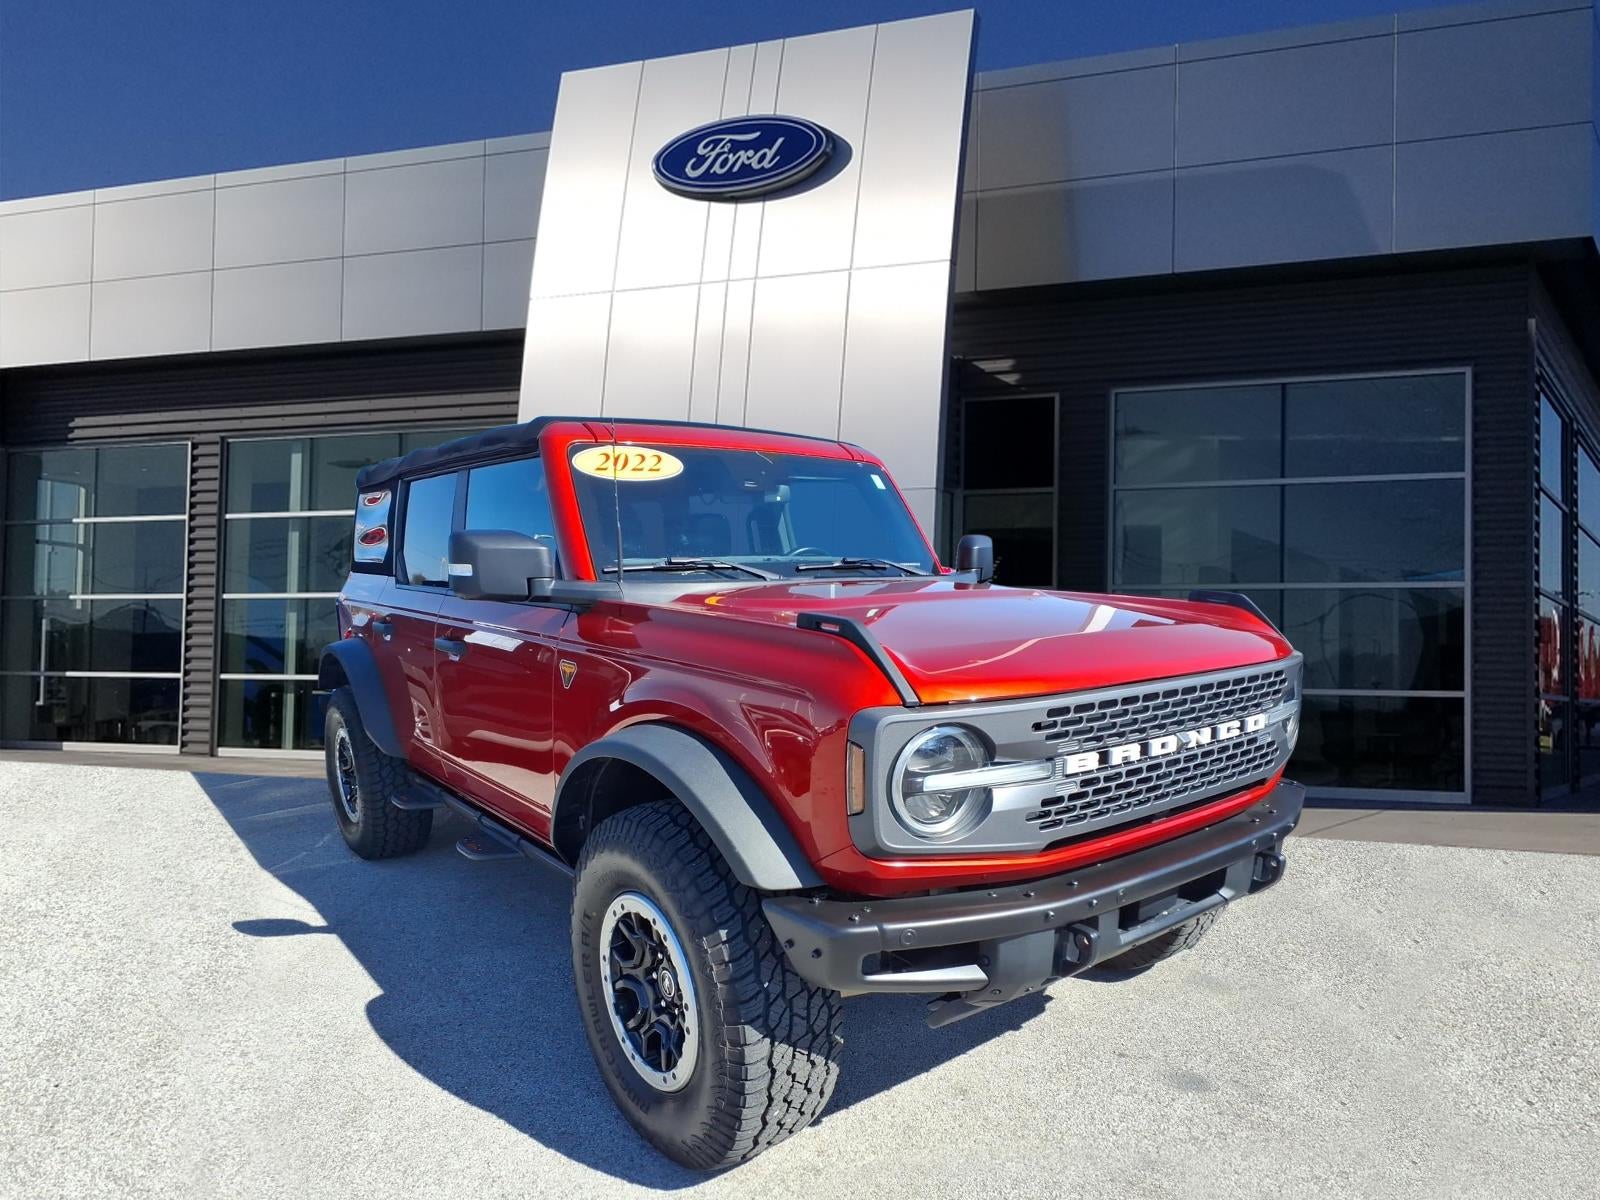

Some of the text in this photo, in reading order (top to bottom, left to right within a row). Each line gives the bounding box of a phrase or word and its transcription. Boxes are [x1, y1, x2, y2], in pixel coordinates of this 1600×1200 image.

[685, 131, 785, 178] Ford
[594, 452, 663, 472] 2022
[1063, 713, 1267, 775] BRONCO
